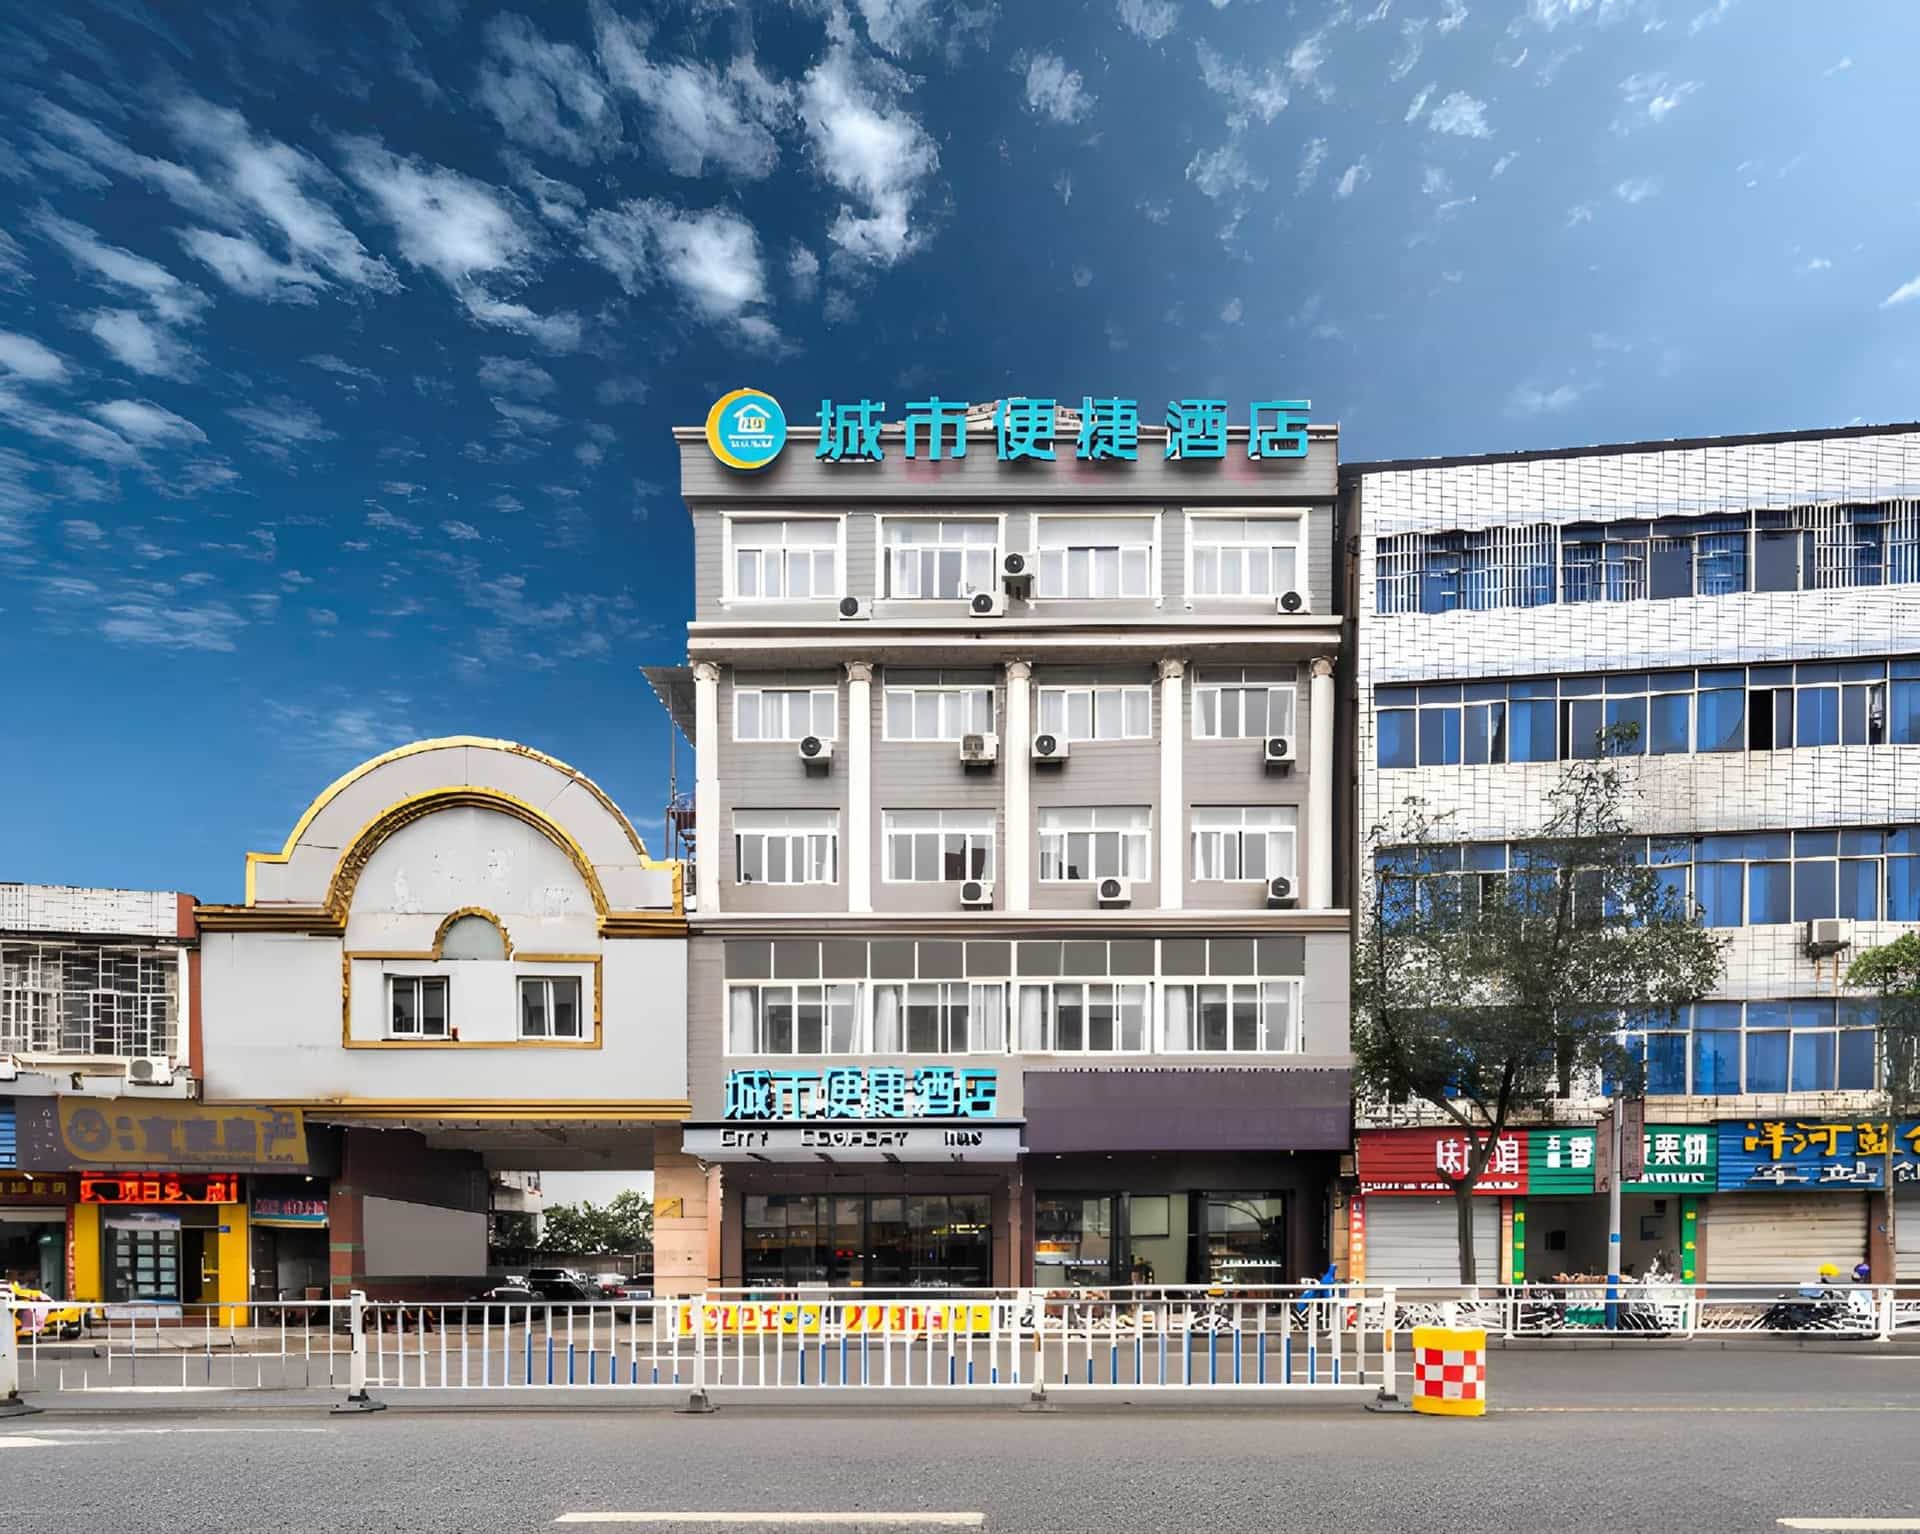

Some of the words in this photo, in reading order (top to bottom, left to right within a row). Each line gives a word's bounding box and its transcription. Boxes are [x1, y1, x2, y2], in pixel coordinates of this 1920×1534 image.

[815, 397, 1311, 462] 城市便捷酒店
[724, 1066, 998, 1119] 城市便捷酒店
